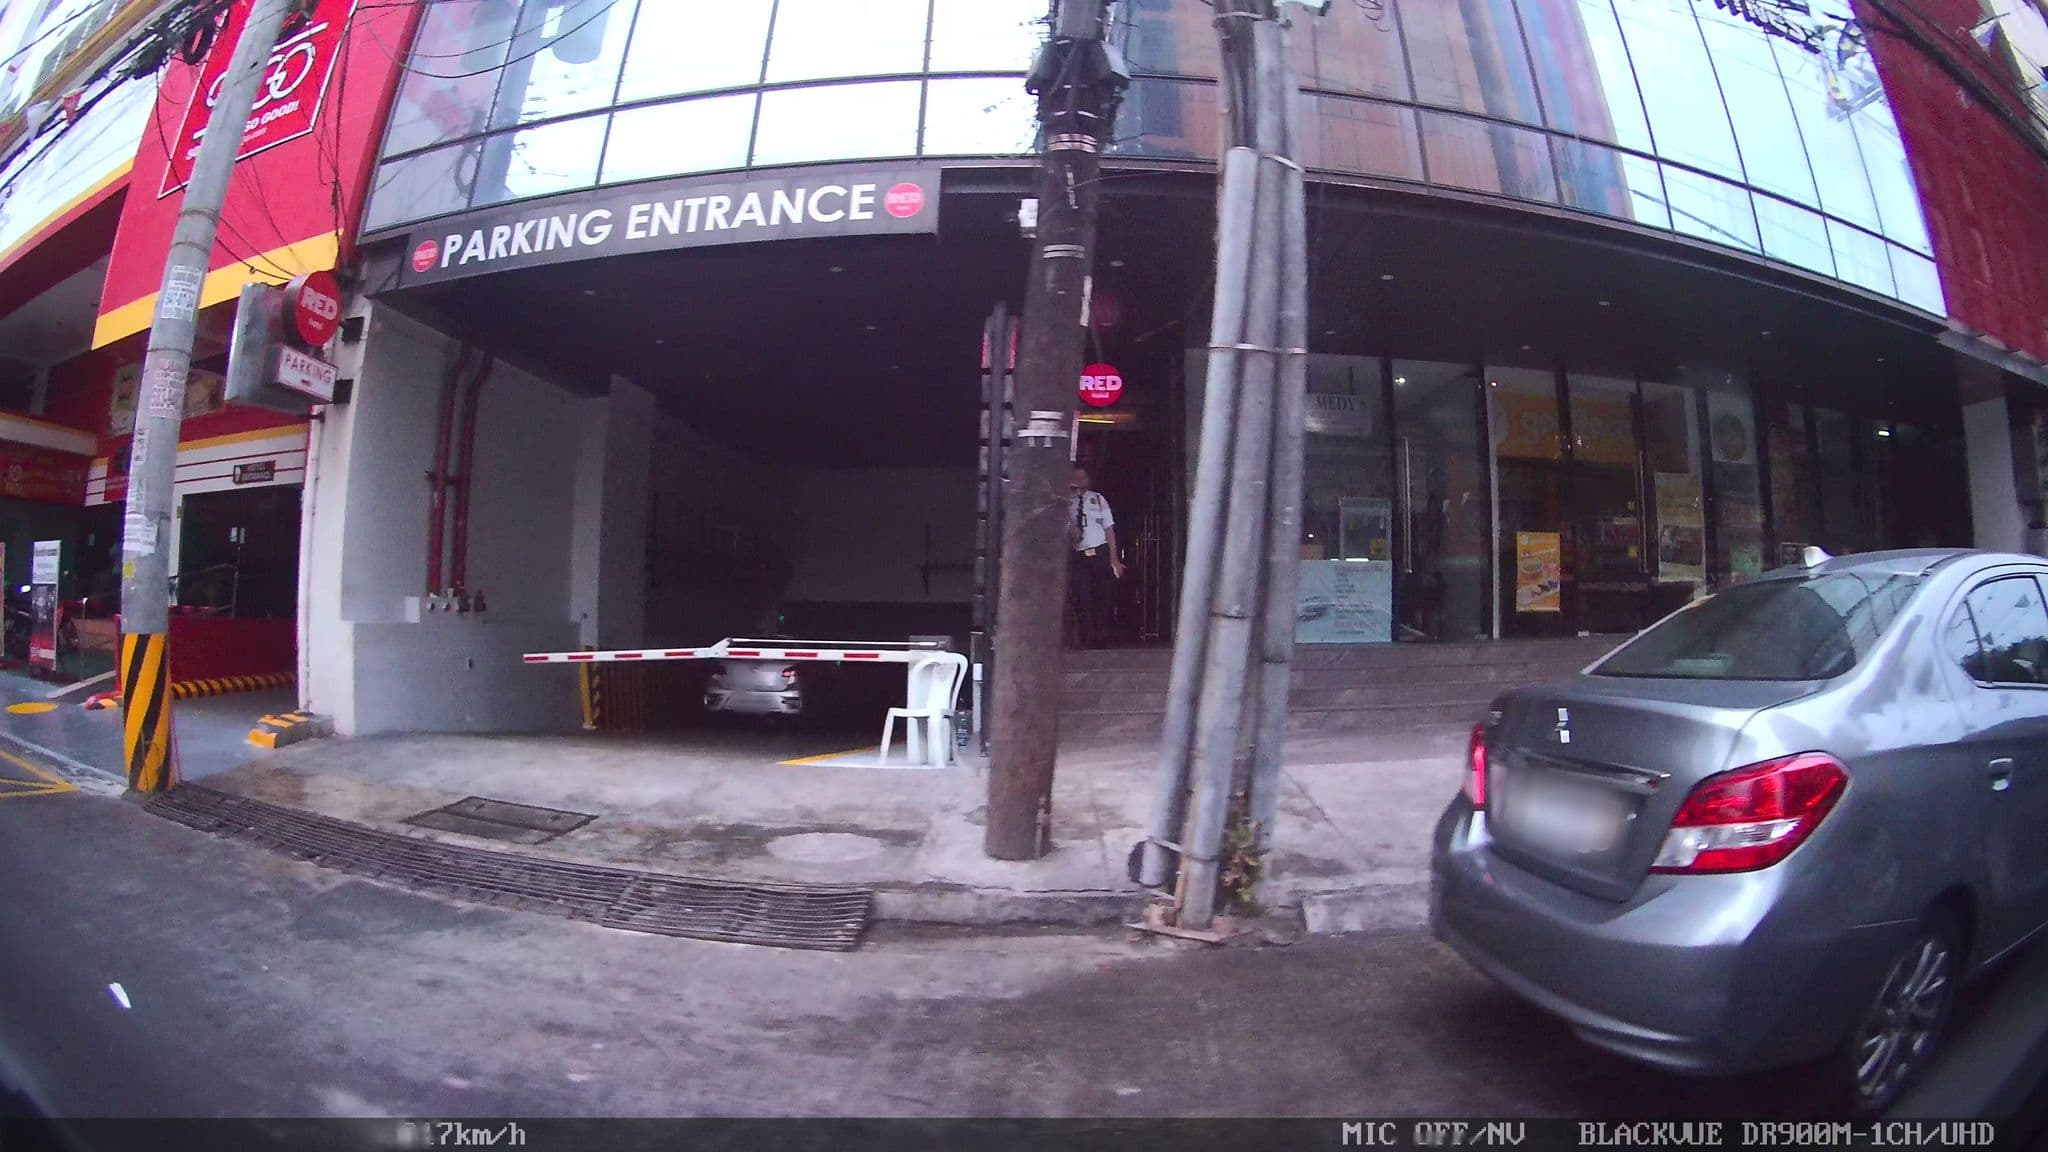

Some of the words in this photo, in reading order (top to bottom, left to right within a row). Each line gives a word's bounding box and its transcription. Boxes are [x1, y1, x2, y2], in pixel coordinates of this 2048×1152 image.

[261, 100, 300, 125] GOOD!
[440, 208, 614, 269] PARKING
[625, 183, 877, 240] ENTRANCE
[301, 286, 338, 321] RED
[285, 352, 332, 384] PARKING
[1080, 376, 1122, 390] RED
